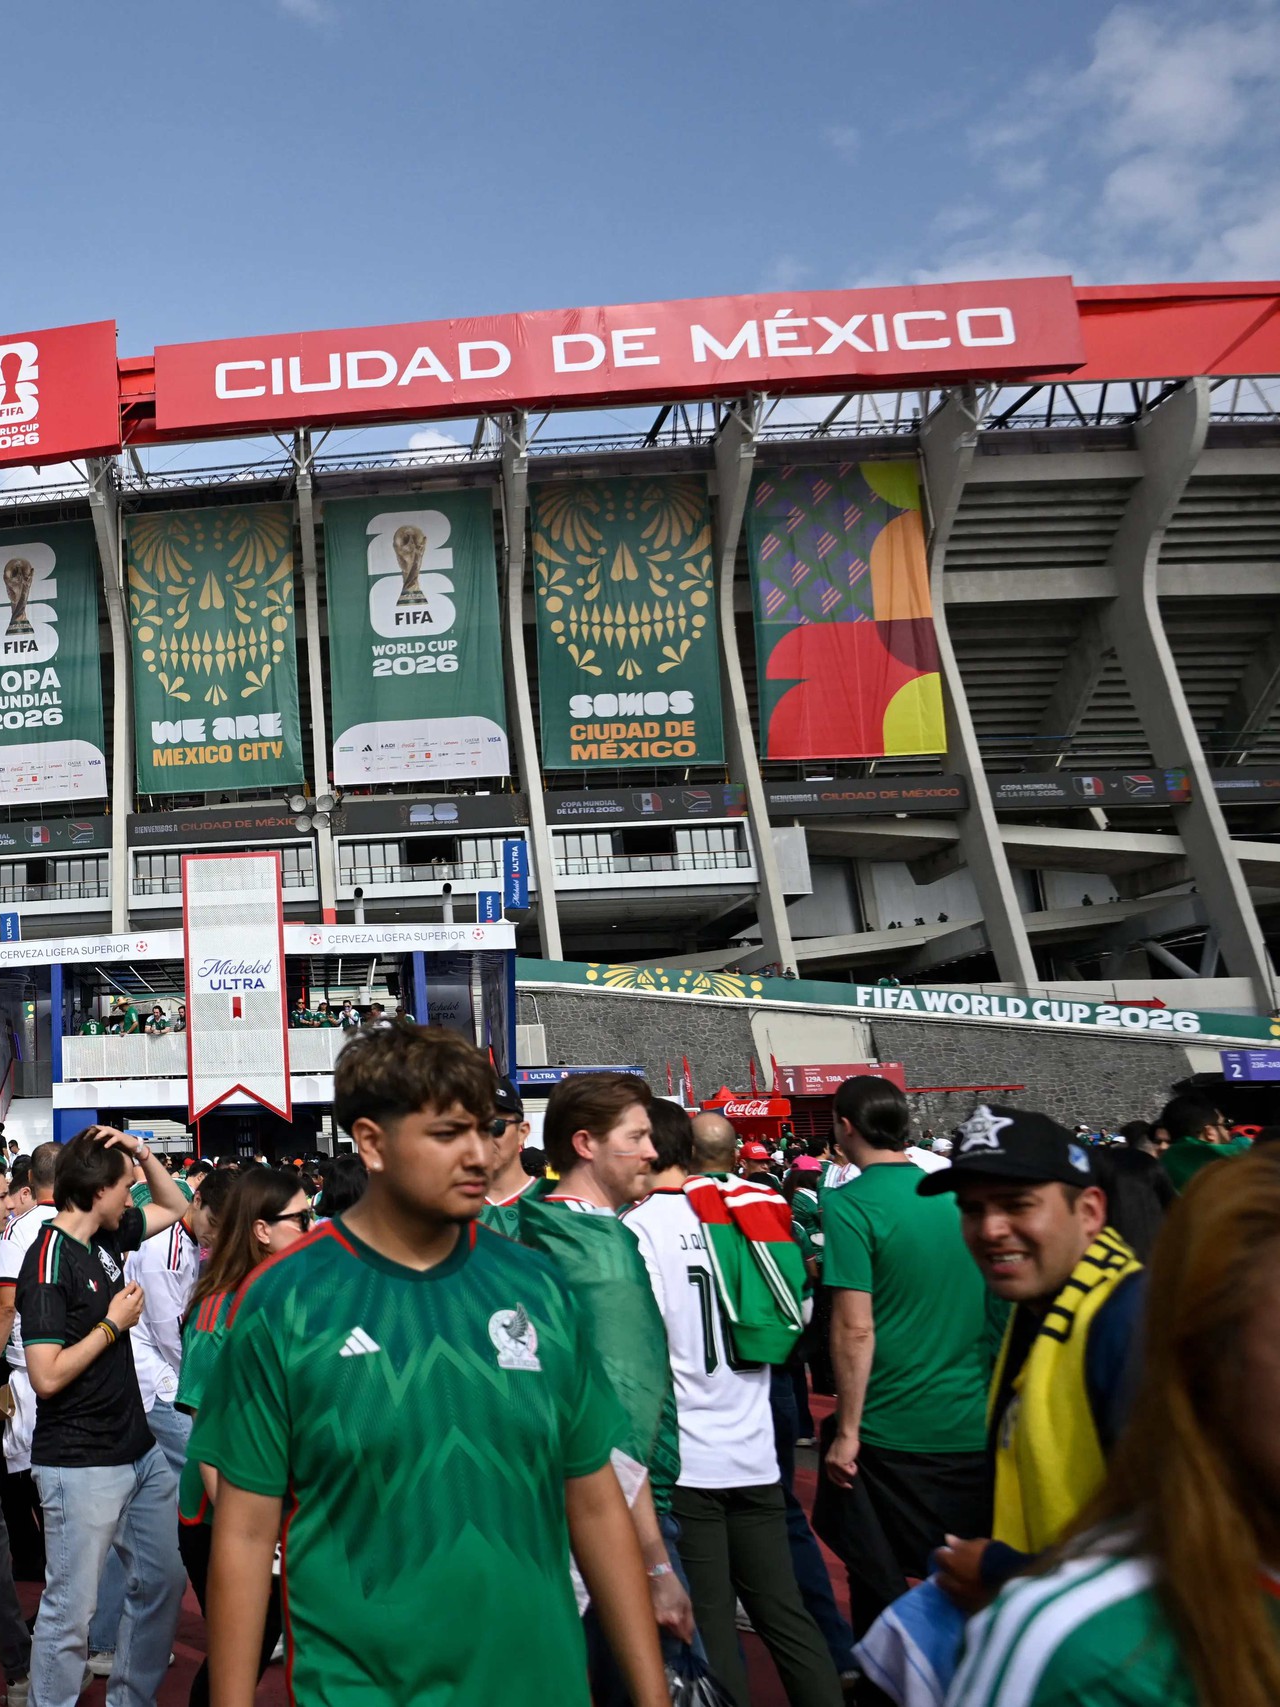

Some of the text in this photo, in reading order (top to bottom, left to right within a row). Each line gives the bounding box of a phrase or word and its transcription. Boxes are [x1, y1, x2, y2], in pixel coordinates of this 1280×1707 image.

[214, 307, 1015, 400] CIUDAD DE MÉXICO
[16, 423, 39, 435] CUP
[395, 611, 433, 626] FIFA
[3, 639, 39, 654] FIFA
[372, 639, 458, 657] WORLD CUP
[372, 654, 459, 677] 2026
[569, 690, 694, 719] SOMOS
[570, 720, 695, 741] CIUDAD DE
[152, 741, 283, 767] MEXICO CITY
[571, 739, 696, 760] MÉXICO
[821, 792, 876, 801] CIUDAD
[879, 790, 899, 799] DE
[902, 787, 961, 799] MÉXICO
[1022, 782, 1058, 790] MUNDIAL
[583, 799, 617, 807] MUNDIAL
[409, 802, 459, 822] 26
[181, 821, 232, 832] CIUDAD
[235, 819, 252, 828] DE
[255, 816, 297, 828] MÉXIC
[511, 878, 521, 908] Michelob
[328, 930, 466, 946] CERVEZA LIGERA SUPERIOR
[0, 943, 130, 961] CERVEZA LIGERA SUPERIOR
[197, 958, 272, 978] Michelob
[210, 977, 265, 990] ULTRA
[856, 986, 1201, 1034] FIFA WORLD CUP 2026
[90, 1024, 97, 1035] 9
[530, 1072, 556, 1080] ULTRA
[1230, 1064, 1243, 1078] 2
[785, 1077, 795, 1092] 1
